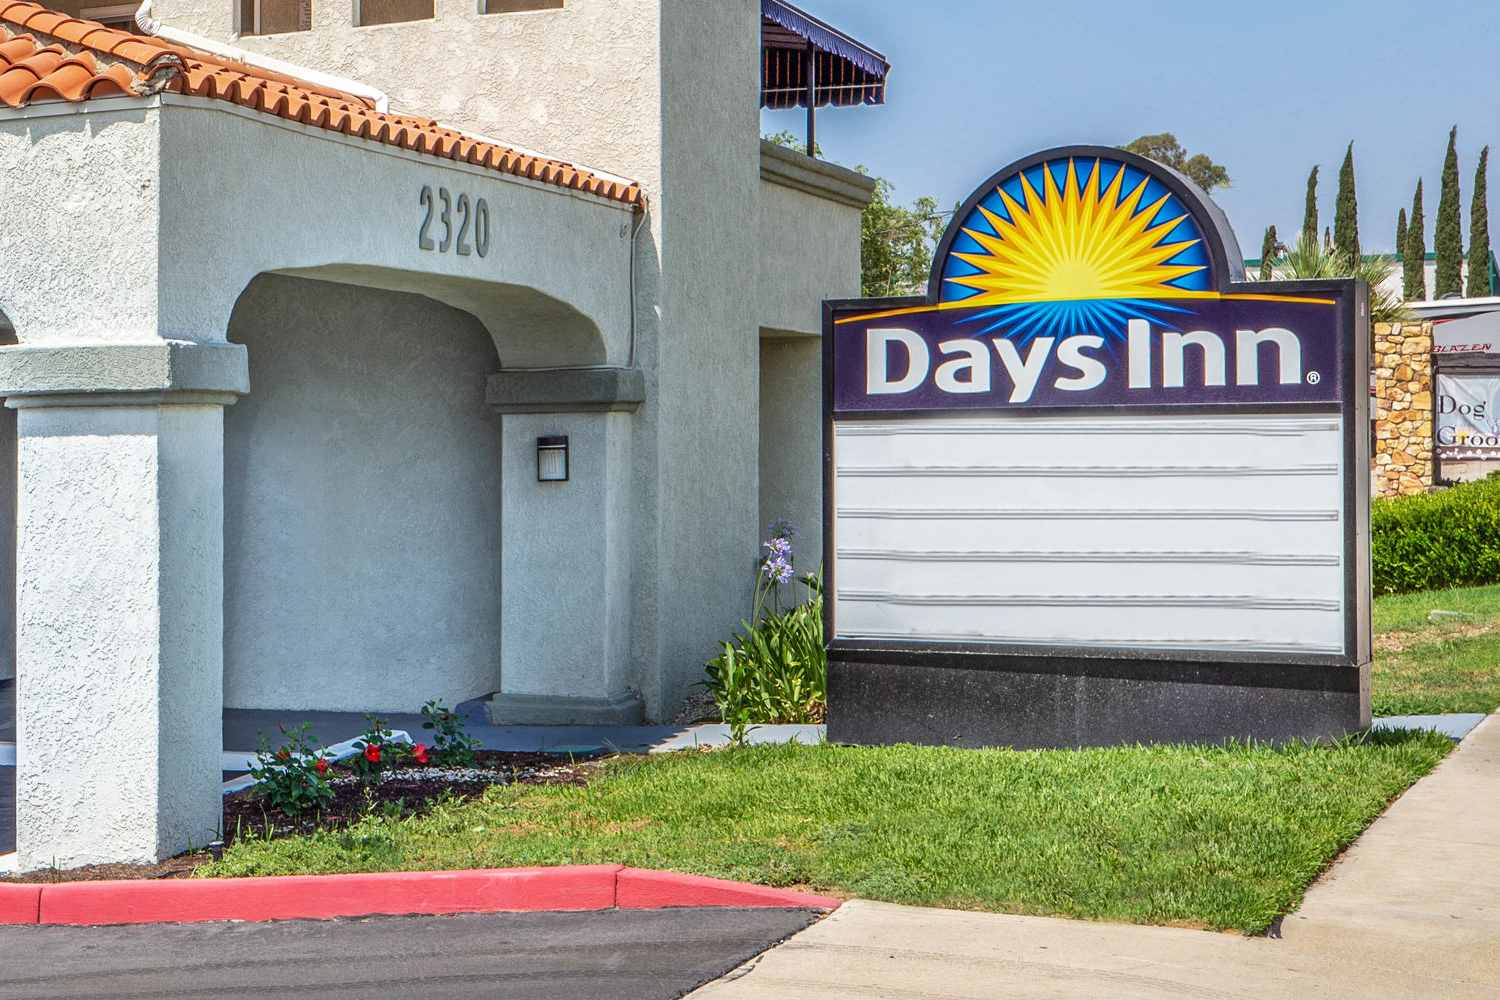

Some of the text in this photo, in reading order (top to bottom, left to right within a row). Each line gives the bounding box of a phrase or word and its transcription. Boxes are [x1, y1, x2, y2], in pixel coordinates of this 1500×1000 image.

[419, 186, 490, 258] 2320
[866, 328, 1107, 403] Days
[1438, 395, 1486, 420] Dog
